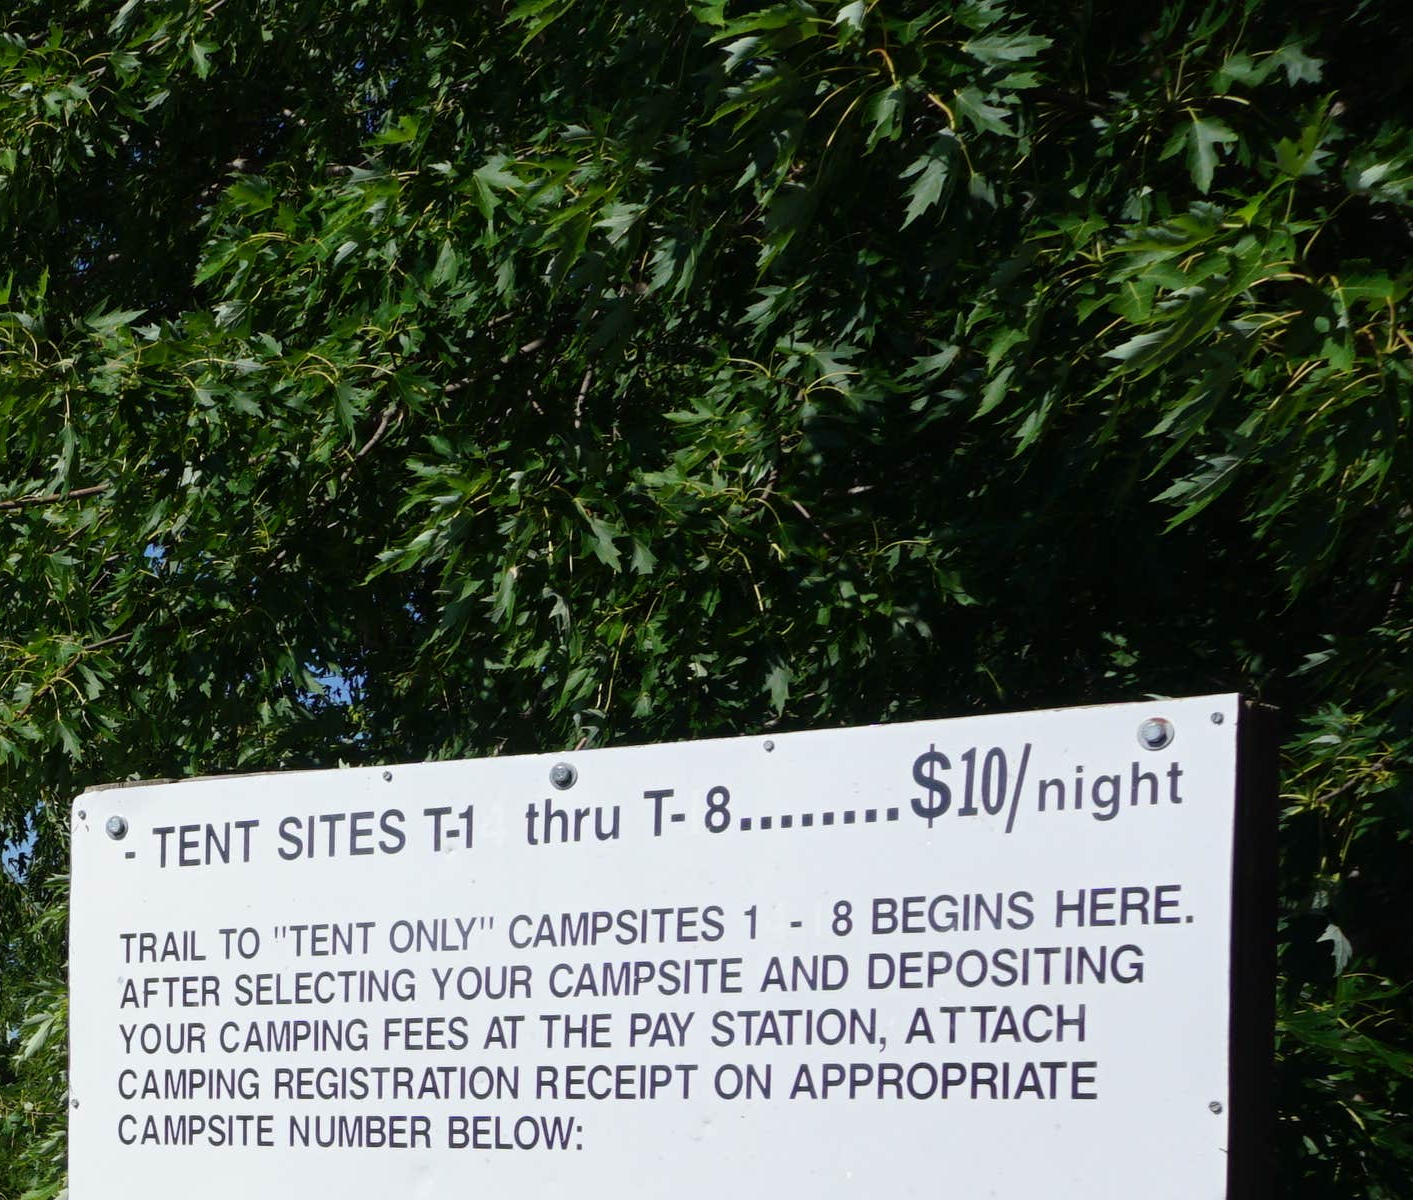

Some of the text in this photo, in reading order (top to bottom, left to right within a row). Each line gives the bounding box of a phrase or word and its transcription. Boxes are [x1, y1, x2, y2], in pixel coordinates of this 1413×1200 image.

[152, 819, 260, 868] TENT
[277, 808, 406, 861] SITES
[423, 805, 474, 852] T-1
[525, 798, 620, 846] thru
[119, 930, 206, 964] TRAIL
[219, 927, 260, 960] TO
[274, 921, 376, 957] "TENT
[389, 916, 494, 954] ONLY"
[508, 905, 725, 949] CAMPSITES
[744, 905, 757, 940] 1
[832, 901, 853, 937] 8
[872, 890, 1035, 935] BEGINS
[1055, 884, 1194, 928] HERE.
[120, 943, 1144, 1009] AFTER SELECTING YOUR CAMPSITE AND DEPOSITING
[119, 1003, 1086, 1055] YOUR CAMPING FEES AT THE PAY STATION, ATTACH
[118, 1061, 1098, 1101] CAMPING REGISTRATION RECEIPT ON APPROPRIATE
[118, 1114, 583, 1151] CAMPSITE NUMBER BELOW:
